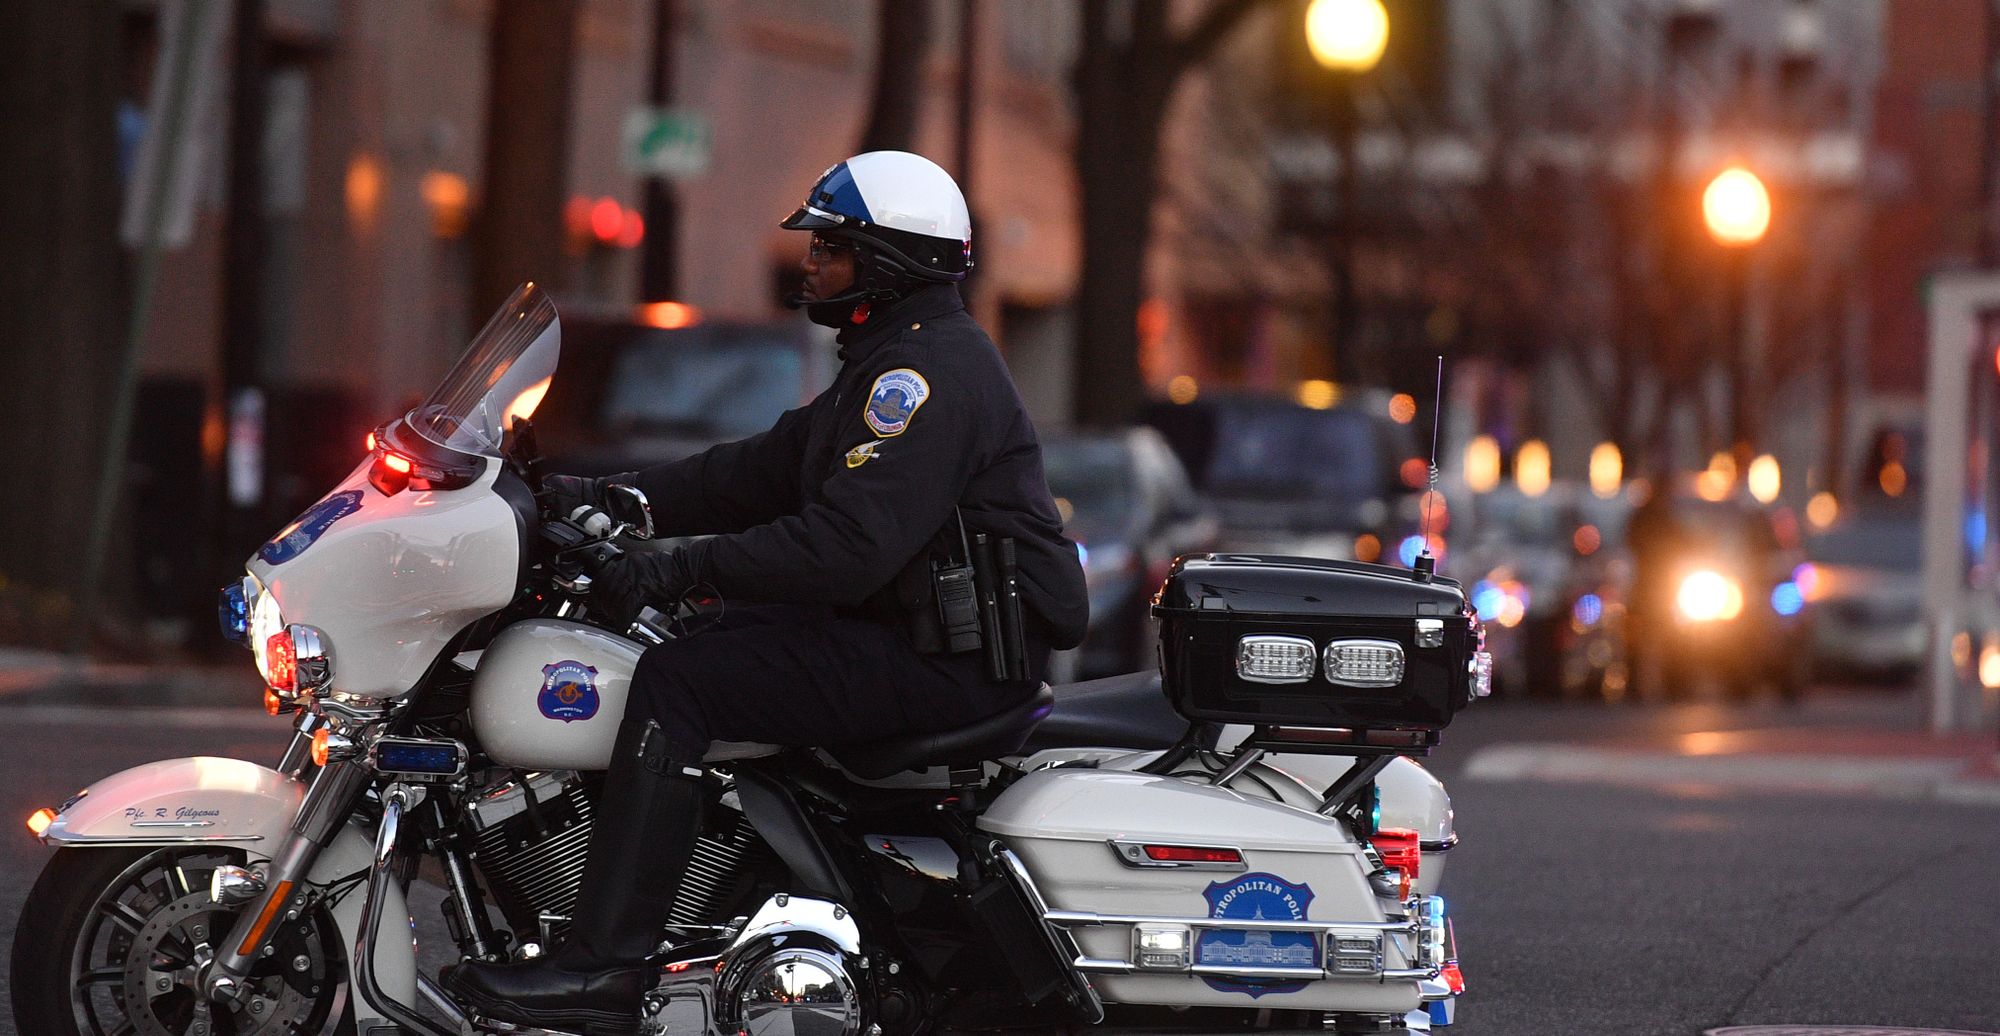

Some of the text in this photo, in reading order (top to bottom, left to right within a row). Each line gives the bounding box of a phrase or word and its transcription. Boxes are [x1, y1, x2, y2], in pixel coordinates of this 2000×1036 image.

[580, 672, 592, 691] POLICE
[175, 806, 220, 820] Gilgeous
[1283, 894, 1303, 920] POLI
